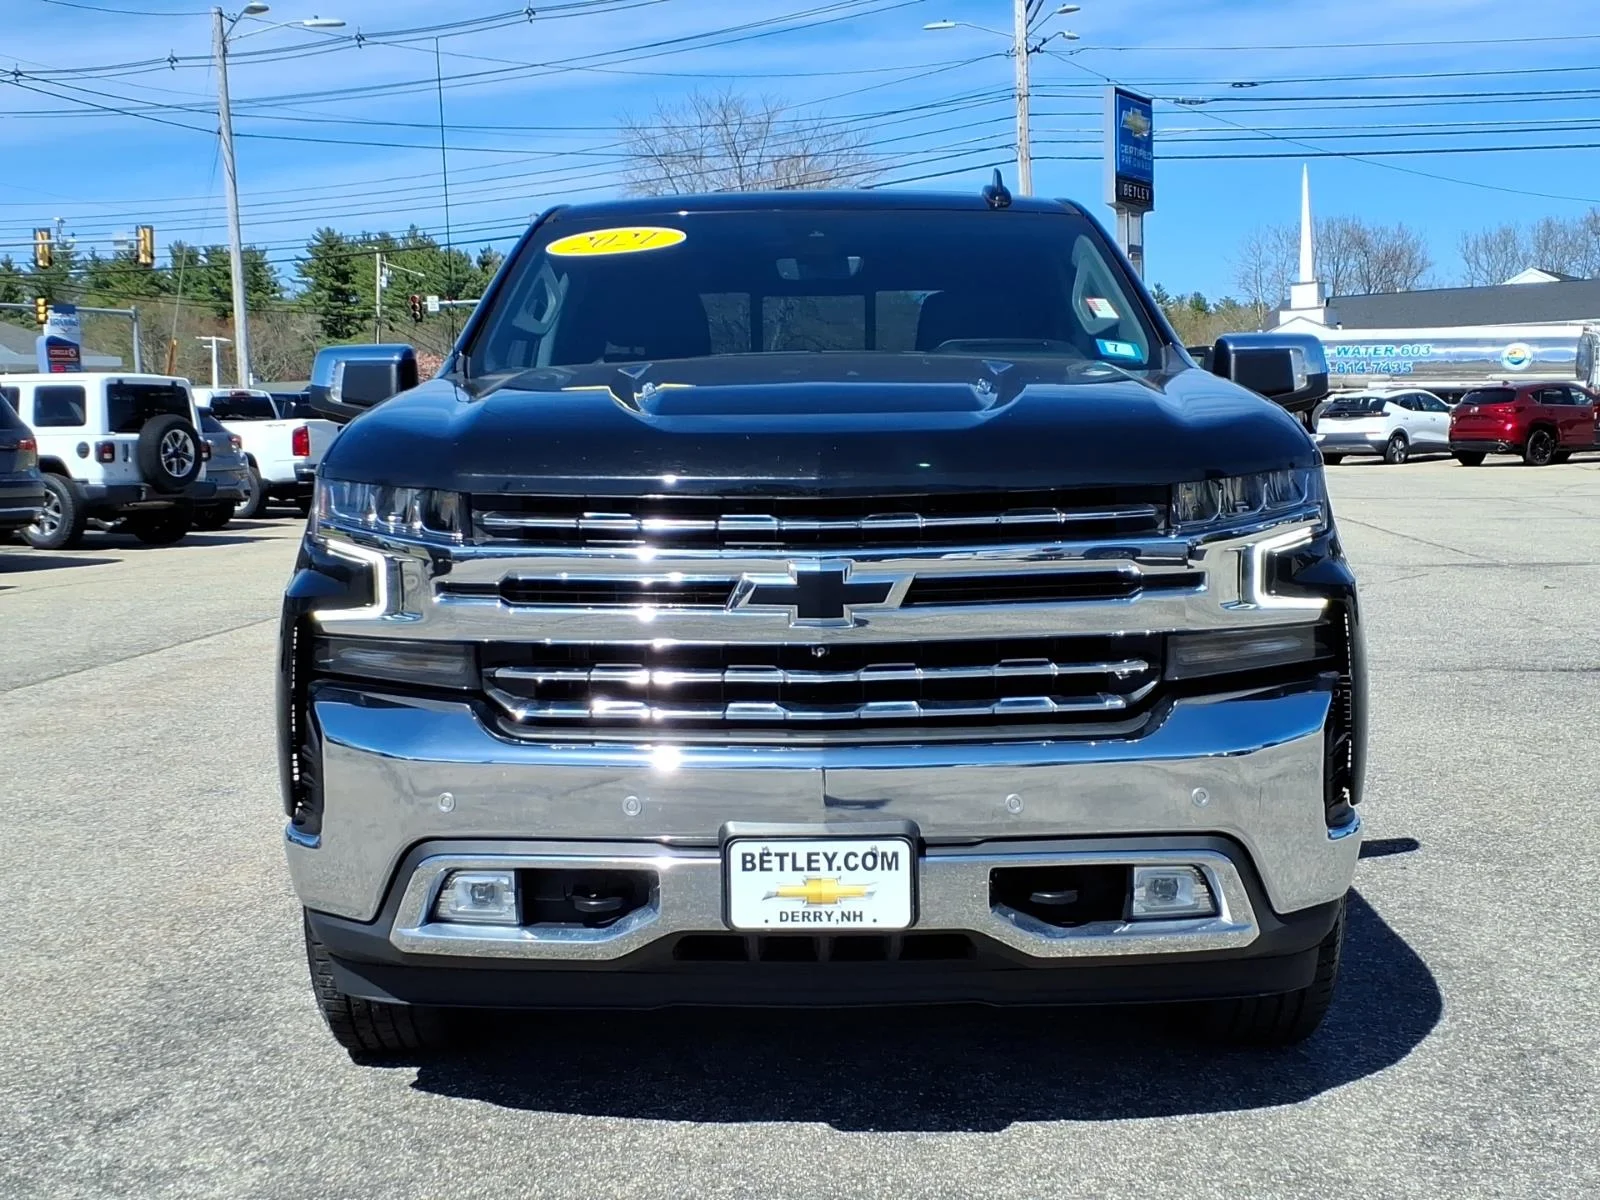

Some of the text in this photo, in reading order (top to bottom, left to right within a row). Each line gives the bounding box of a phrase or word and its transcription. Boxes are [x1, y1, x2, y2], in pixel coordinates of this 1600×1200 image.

[1123, 183, 1150, 201] BETLEY
[1336, 345, 1395, 357] WATER
[1400, 344, 1432, 356] 603
[741, 850, 900, 873] BETLEY.COM
[779, 910, 864, 925] DERRY,NH
